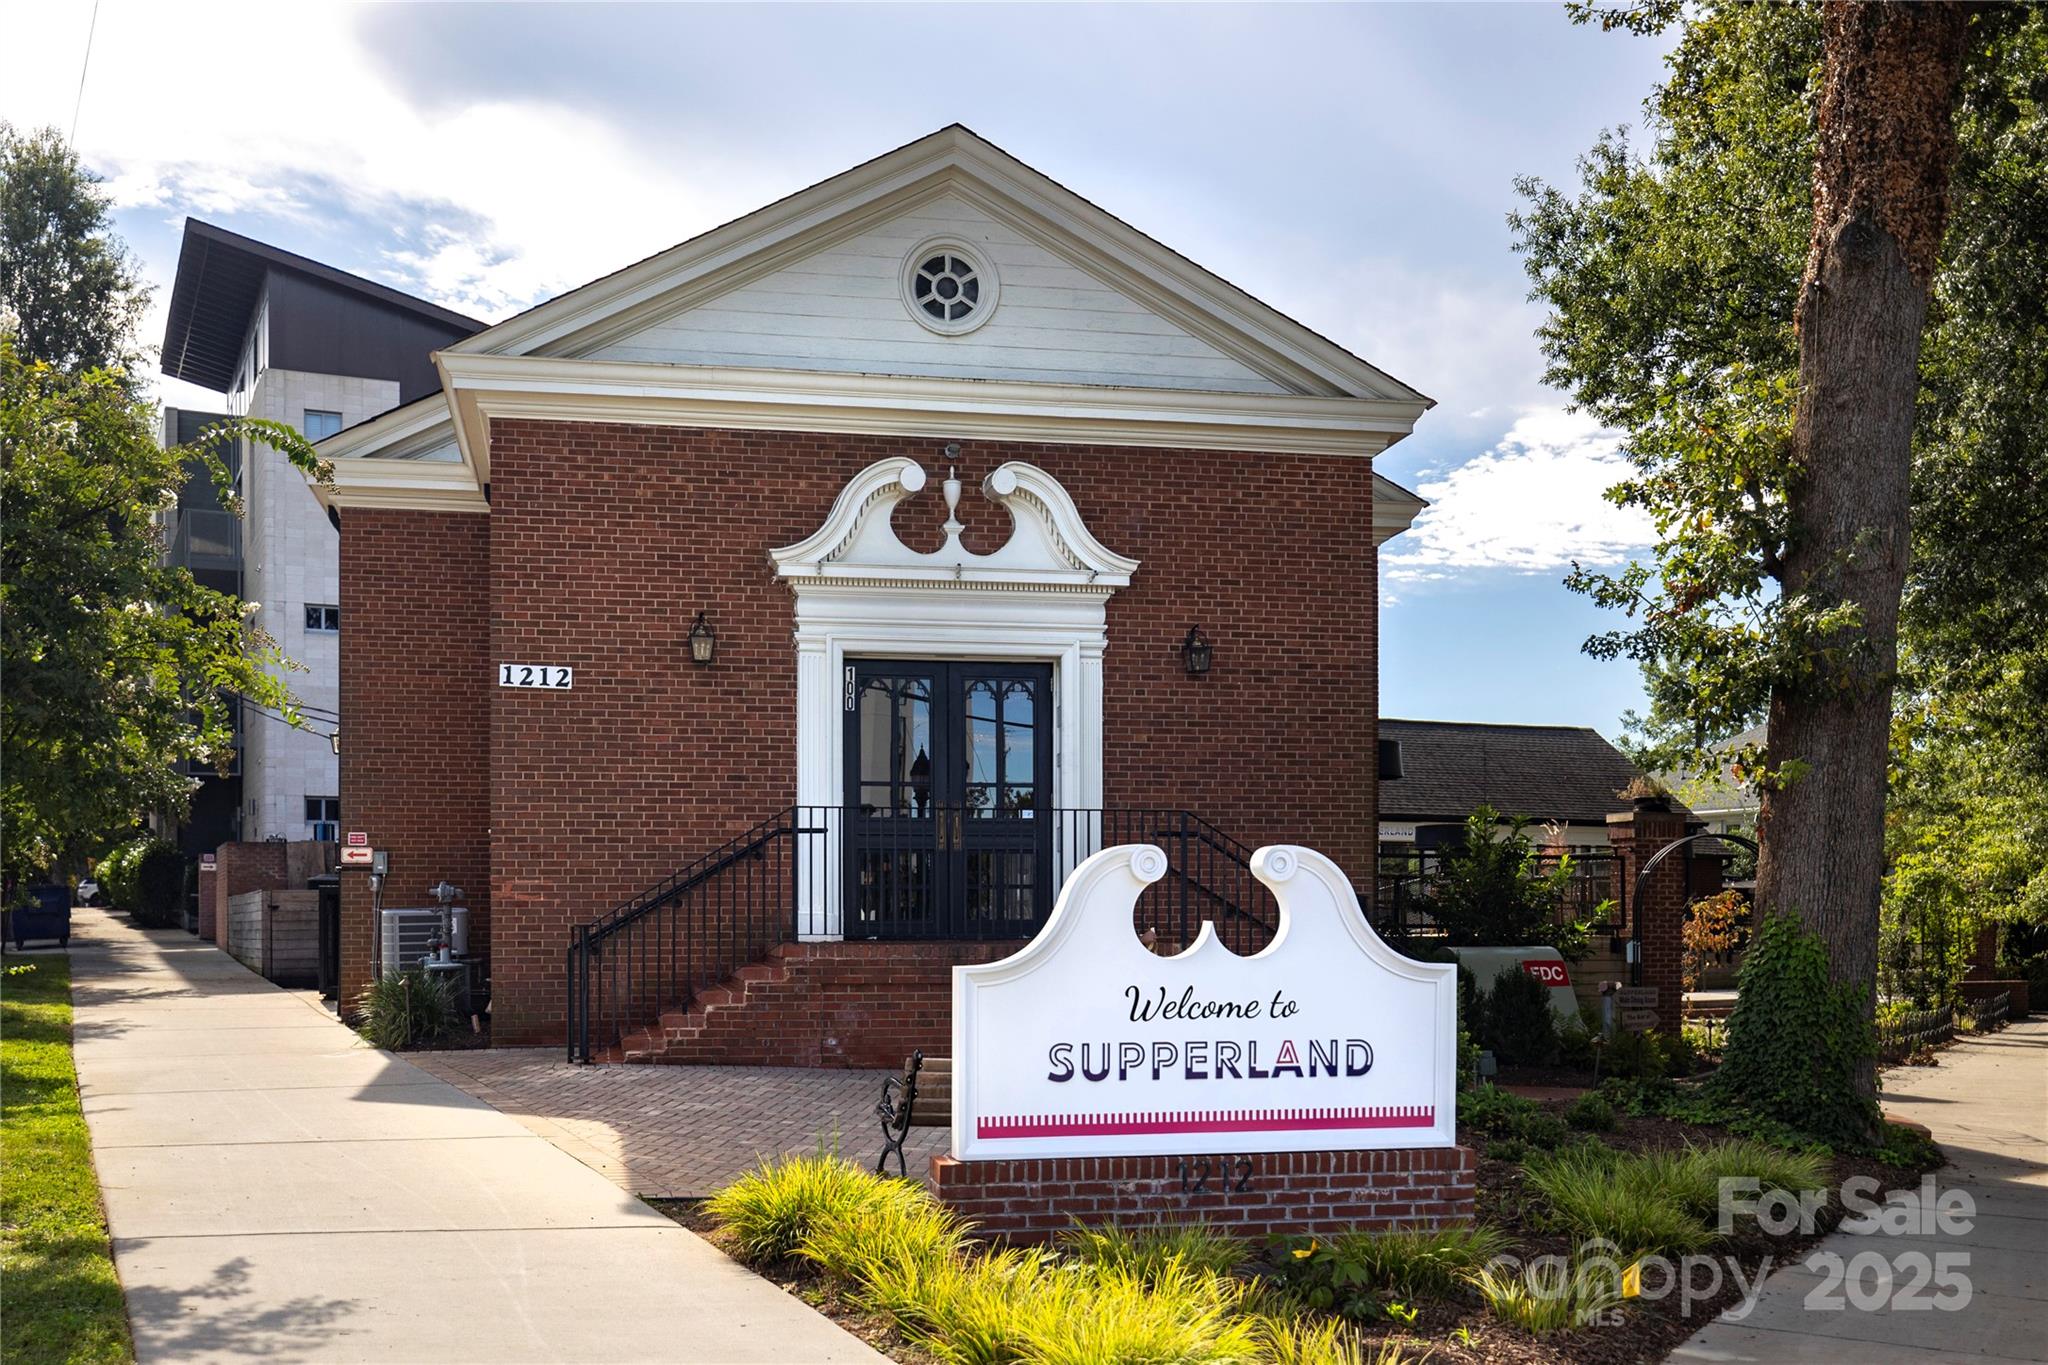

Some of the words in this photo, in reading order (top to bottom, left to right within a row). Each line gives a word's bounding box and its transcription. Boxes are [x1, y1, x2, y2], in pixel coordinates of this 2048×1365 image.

[503, 665, 570, 688] 1212
[846, 667, 854, 710] 100
[1529, 965, 1564, 981] FDC
[1124, 985, 1262, 1023] Welcome
[1269, 989, 1300, 1019] to
[1047, 1039, 1374, 1083] SUPPERLAND
[1175, 1158, 1254, 1195] 1212
